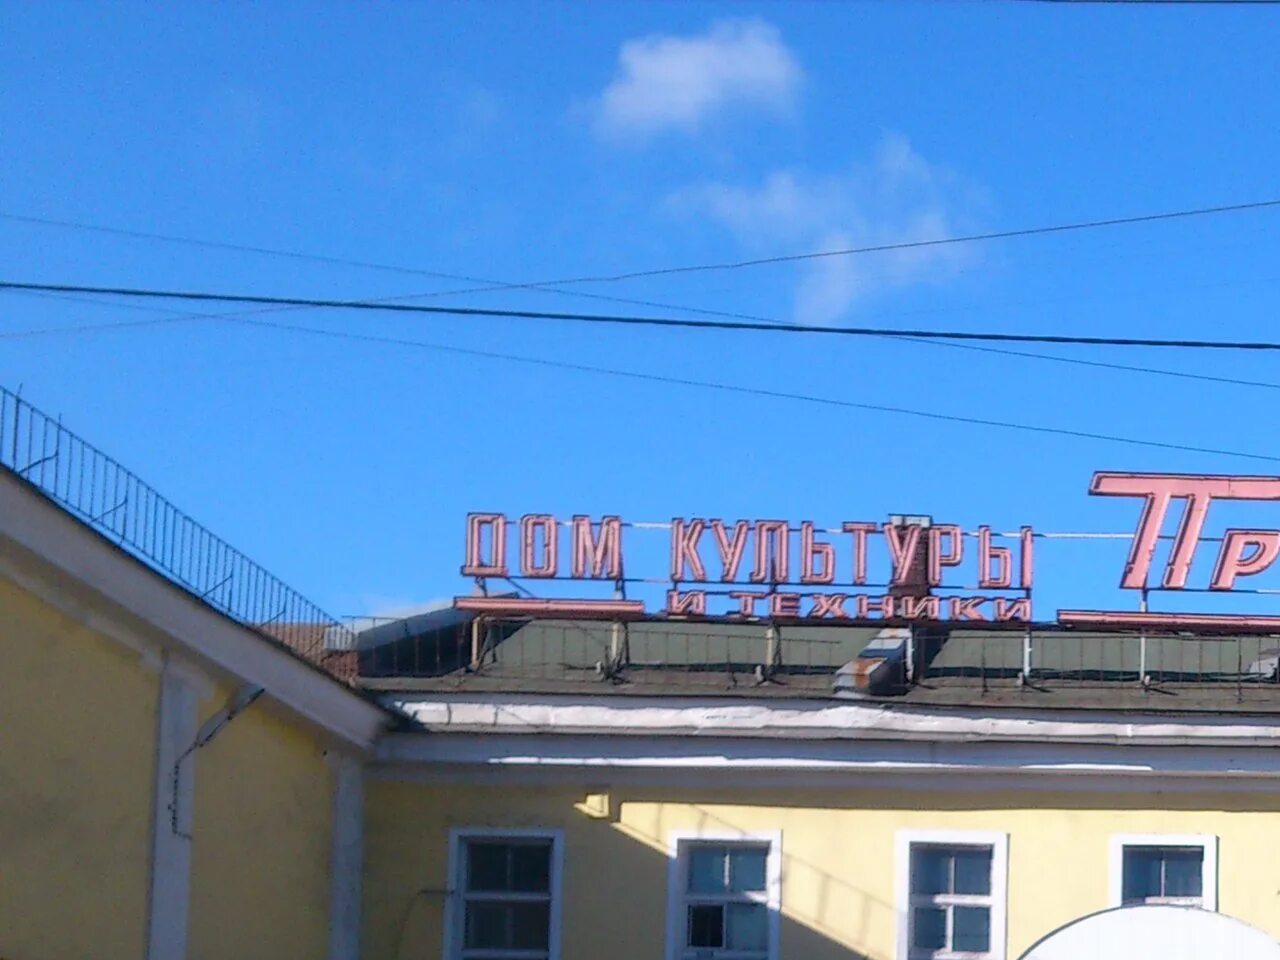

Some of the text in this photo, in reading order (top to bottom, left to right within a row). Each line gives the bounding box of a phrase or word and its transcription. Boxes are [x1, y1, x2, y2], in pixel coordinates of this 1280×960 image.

[460, 511, 1034, 589] ДОМ КУЛЬТУРЫ
[667, 589, 1034, 623] И ТЕХНИКИ
